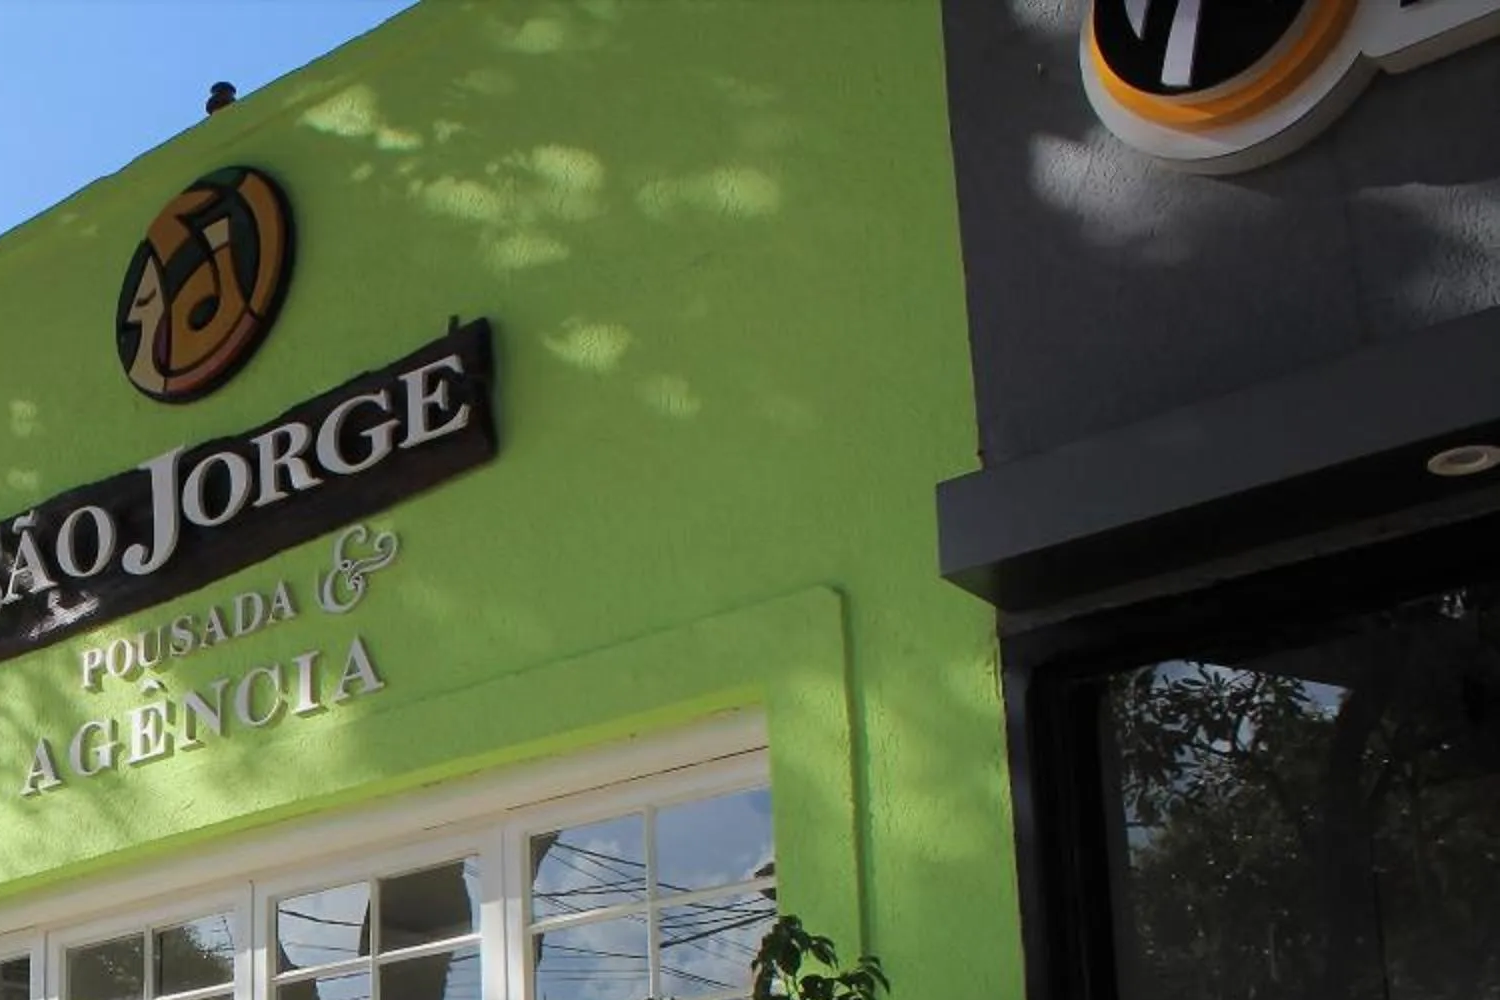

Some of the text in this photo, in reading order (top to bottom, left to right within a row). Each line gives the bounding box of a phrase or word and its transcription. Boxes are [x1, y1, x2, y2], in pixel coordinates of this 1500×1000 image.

[122, 354, 470, 577] JORGE
[80, 524, 399, 689] POUSADA &
[20, 636, 385, 797] AGÊNCIA
